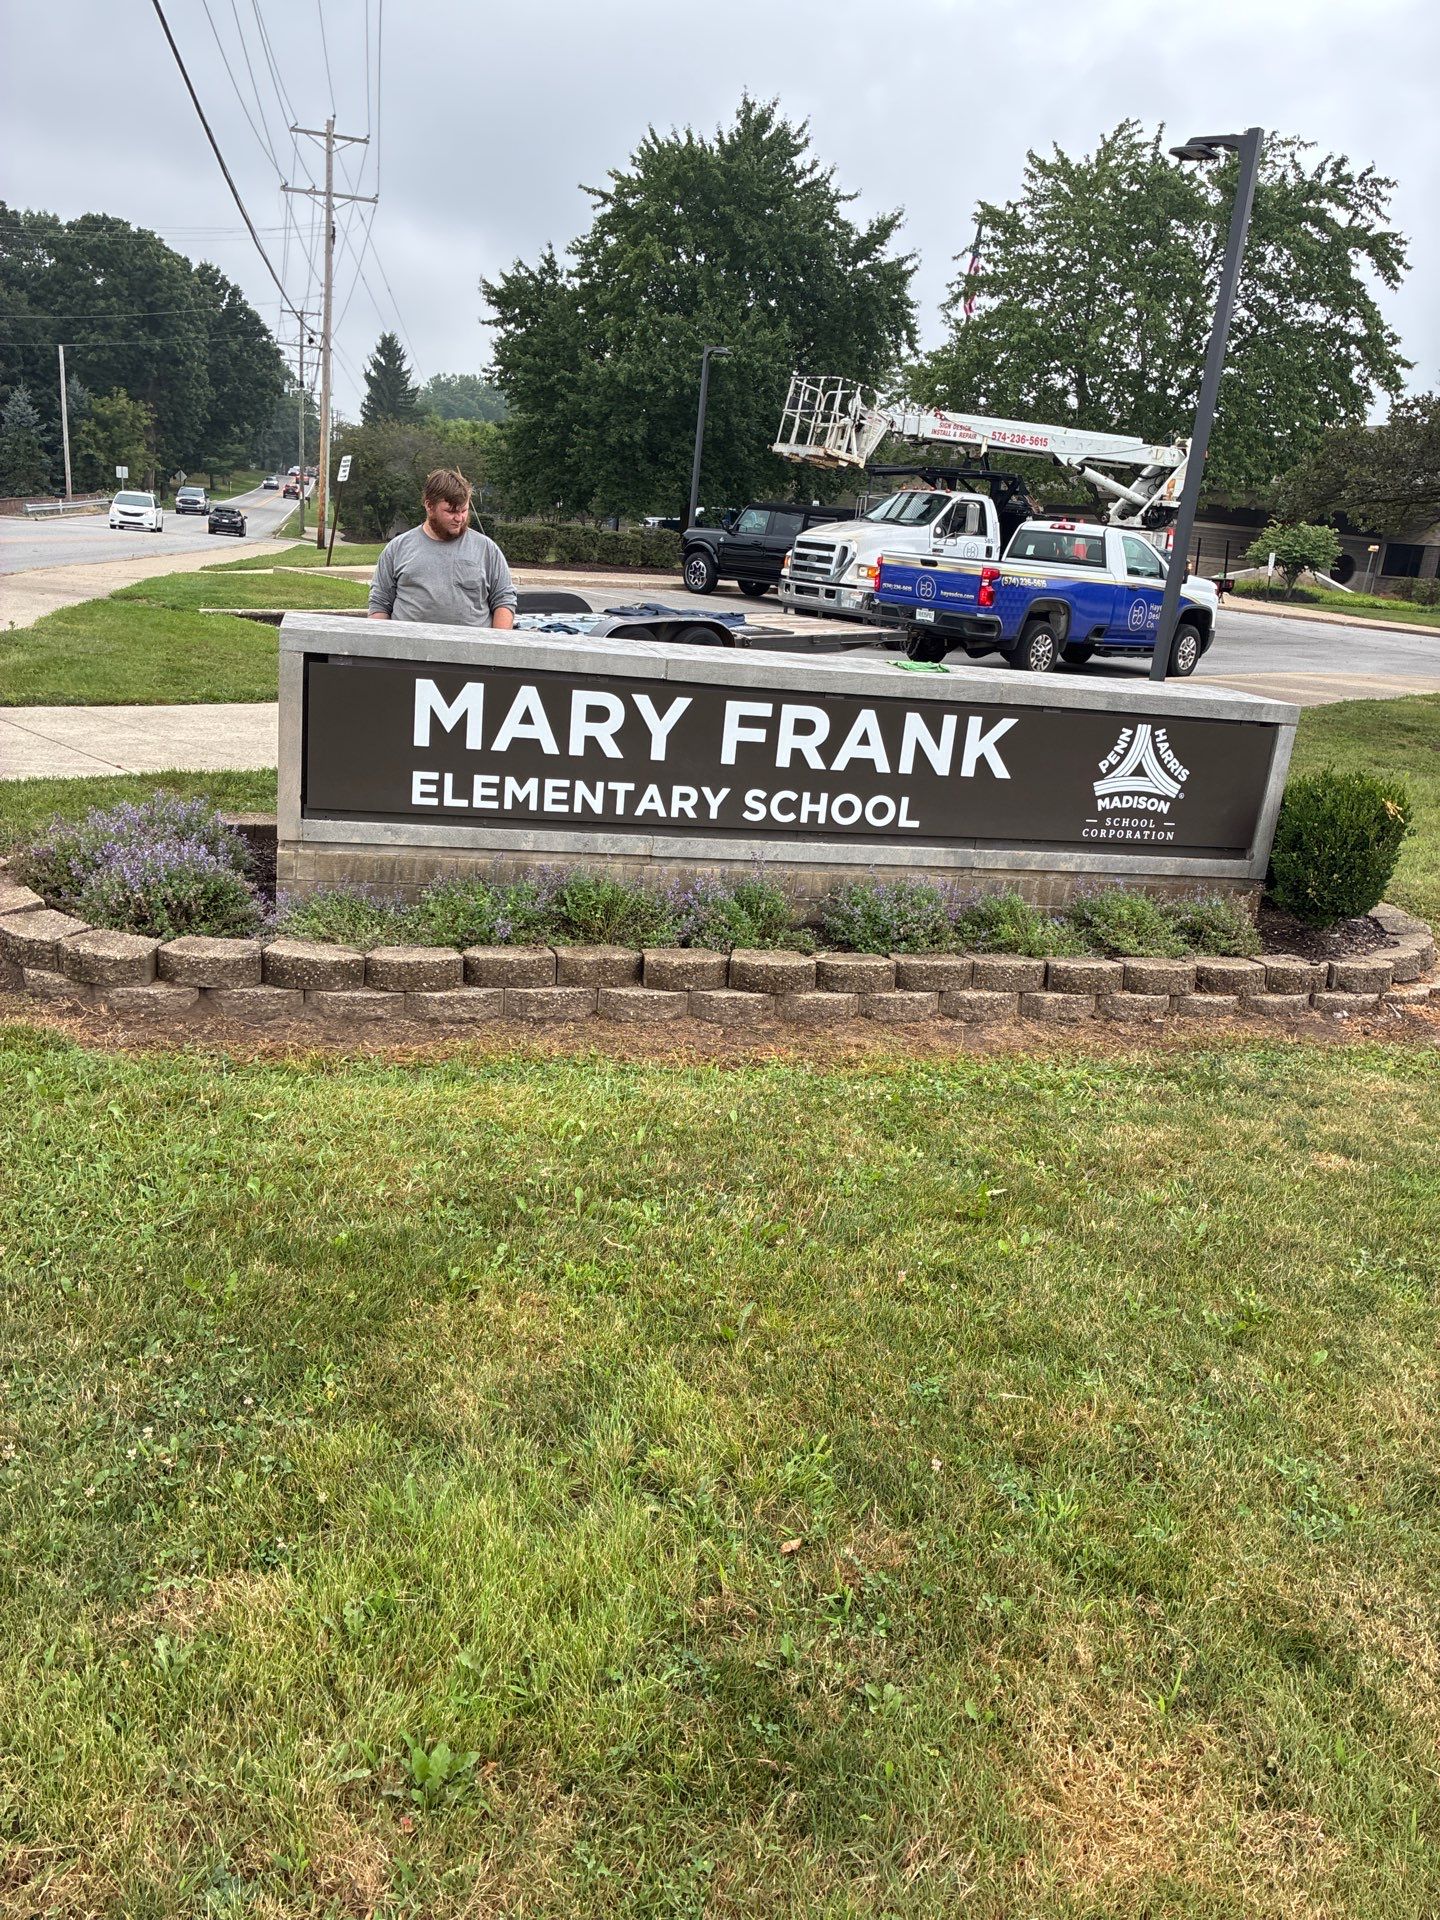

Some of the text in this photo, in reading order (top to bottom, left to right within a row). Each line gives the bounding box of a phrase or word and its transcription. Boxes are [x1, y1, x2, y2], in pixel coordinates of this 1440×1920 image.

[931, 429, 952, 437] INSTALL
[959, 432, 978, 440] REPAIR
[991, 431, 1049, 447] 574-236-5615
[1001, 576, 1047, 588] (574) 236-5615
[413, 678, 1019, 779] MARY FRANK
[1098, 727, 1134, 774] PENN
[1154, 728, 1190, 782] HARRIS
[411, 770, 920, 828] ELEMENTARY SCHOOL
[1097, 795, 1171, 815] MADISON
[1105, 817, 1156, 828] SCHOOL
[1082, 828, 1175, 841] CORPORATION
